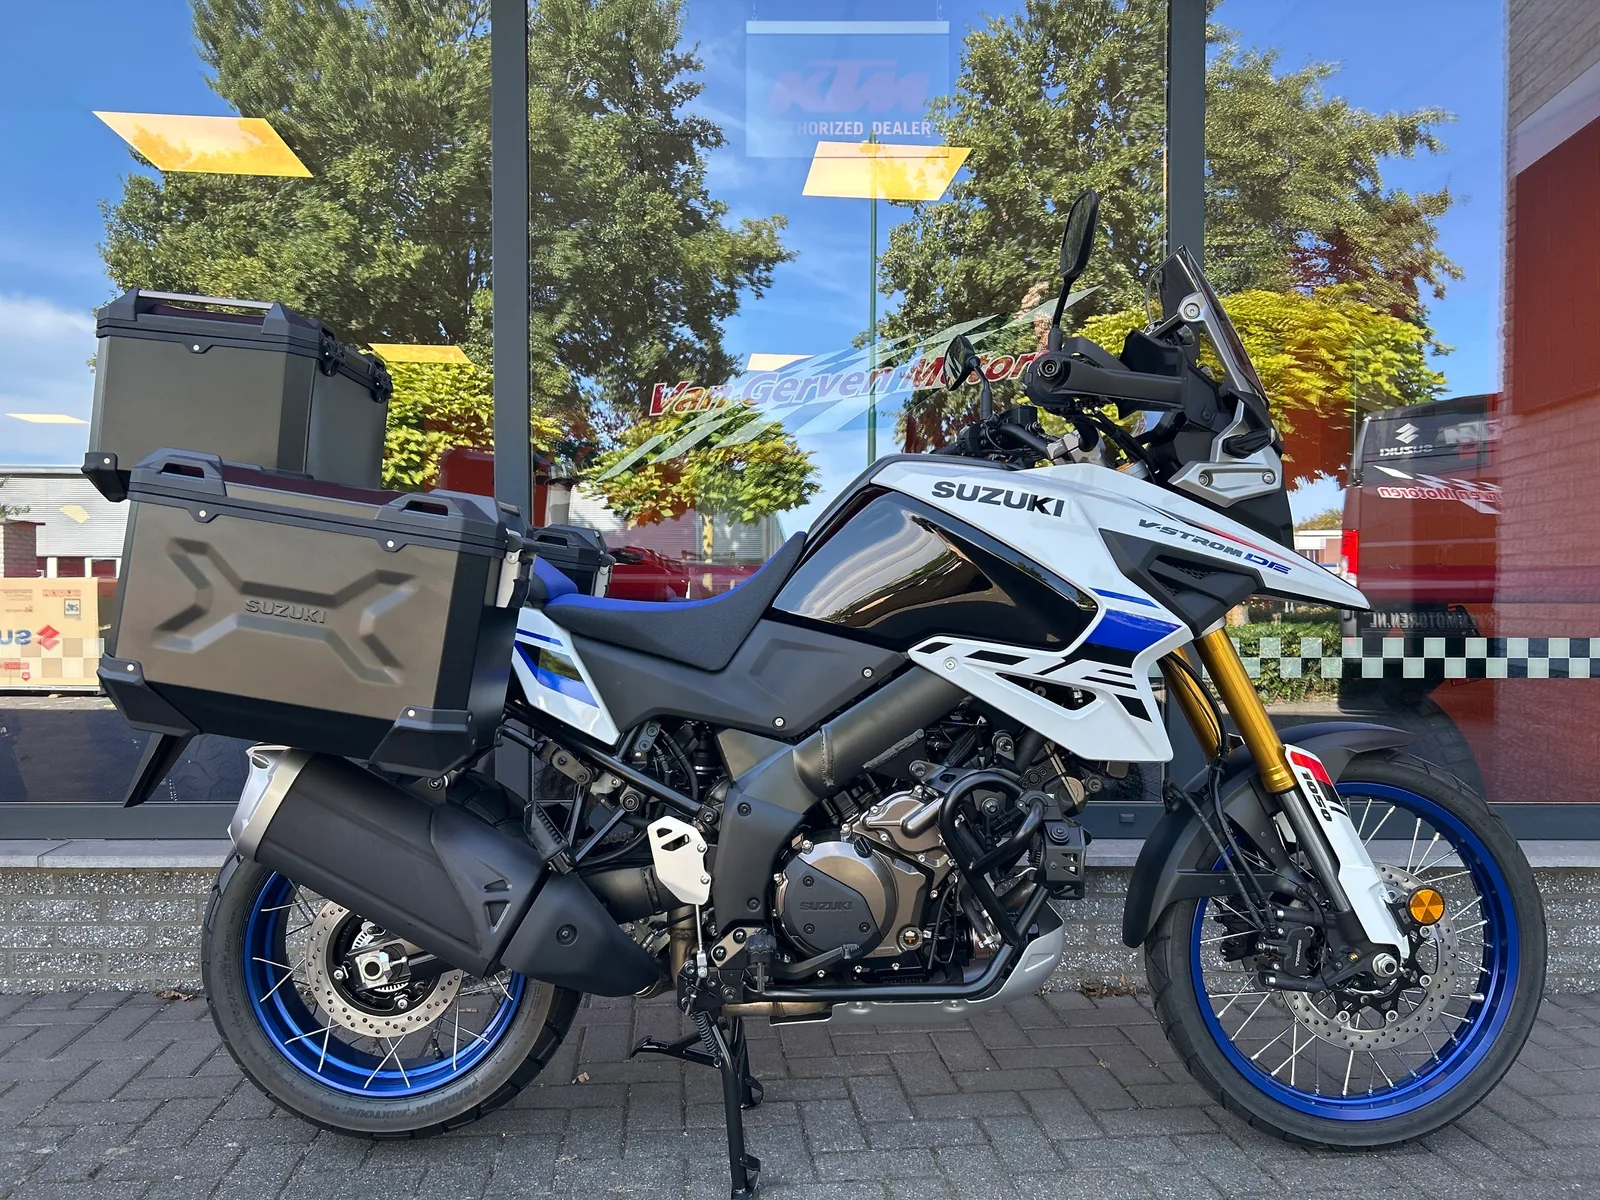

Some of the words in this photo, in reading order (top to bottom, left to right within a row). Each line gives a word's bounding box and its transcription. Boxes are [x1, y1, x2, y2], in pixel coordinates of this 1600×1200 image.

[768, 60, 931, 113] KTM
[796, 121, 864, 136] HORIZED
[873, 121, 932, 137] DEALER
[649, 381, 732, 416] Van
[742, 372, 895, 407] Gerven
[931, 481, 1065, 518] SUZUKI
[1138, 518, 1244, 558] V-STROM
[1243, 553, 1292, 575] DE
[245, 600, 327, 624] SUZUKI
[1301, 771, 1333, 822] 1050
[800, 901, 853, 911] SUZUKI
